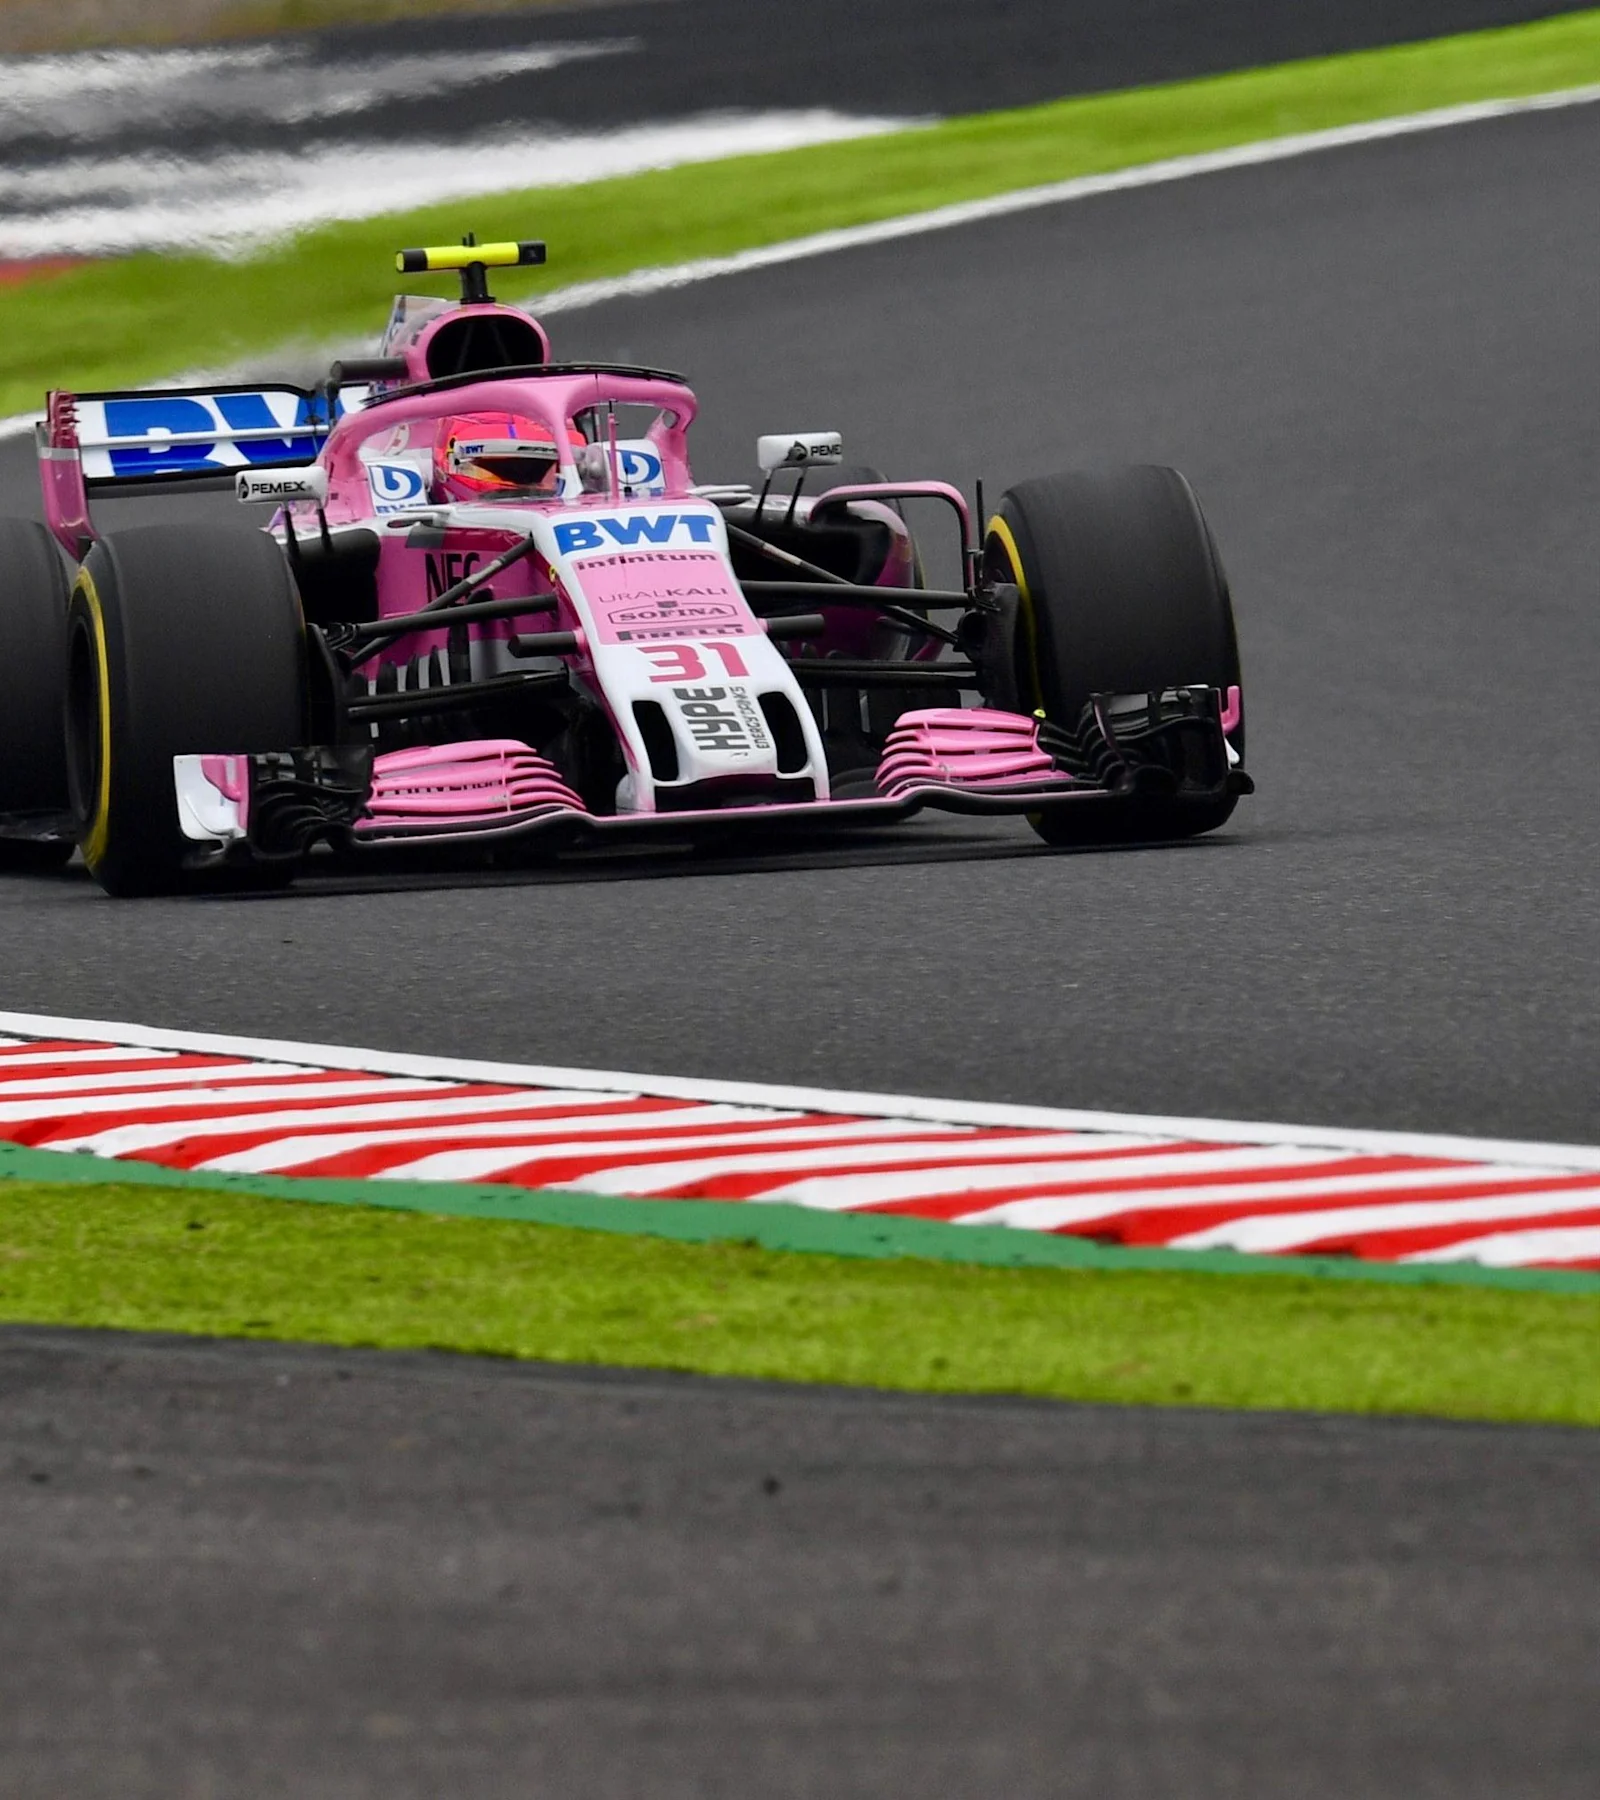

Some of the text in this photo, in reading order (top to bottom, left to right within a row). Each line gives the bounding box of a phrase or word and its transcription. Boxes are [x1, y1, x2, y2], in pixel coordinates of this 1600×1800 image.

[104, 394, 345, 476] BW
[810, 444, 842, 456] PEME
[251, 481, 306, 494] PEMEX
[553, 515, 717, 556] BWT
[577, 553, 717, 570] infinitum
[598, 587, 728, 603] URALKALI
[619, 607, 727, 621] SOFINA
[616, 624, 744, 641] PIRELLI
[636, 642, 750, 683] 31
[672, 687, 751, 751] HYPE
